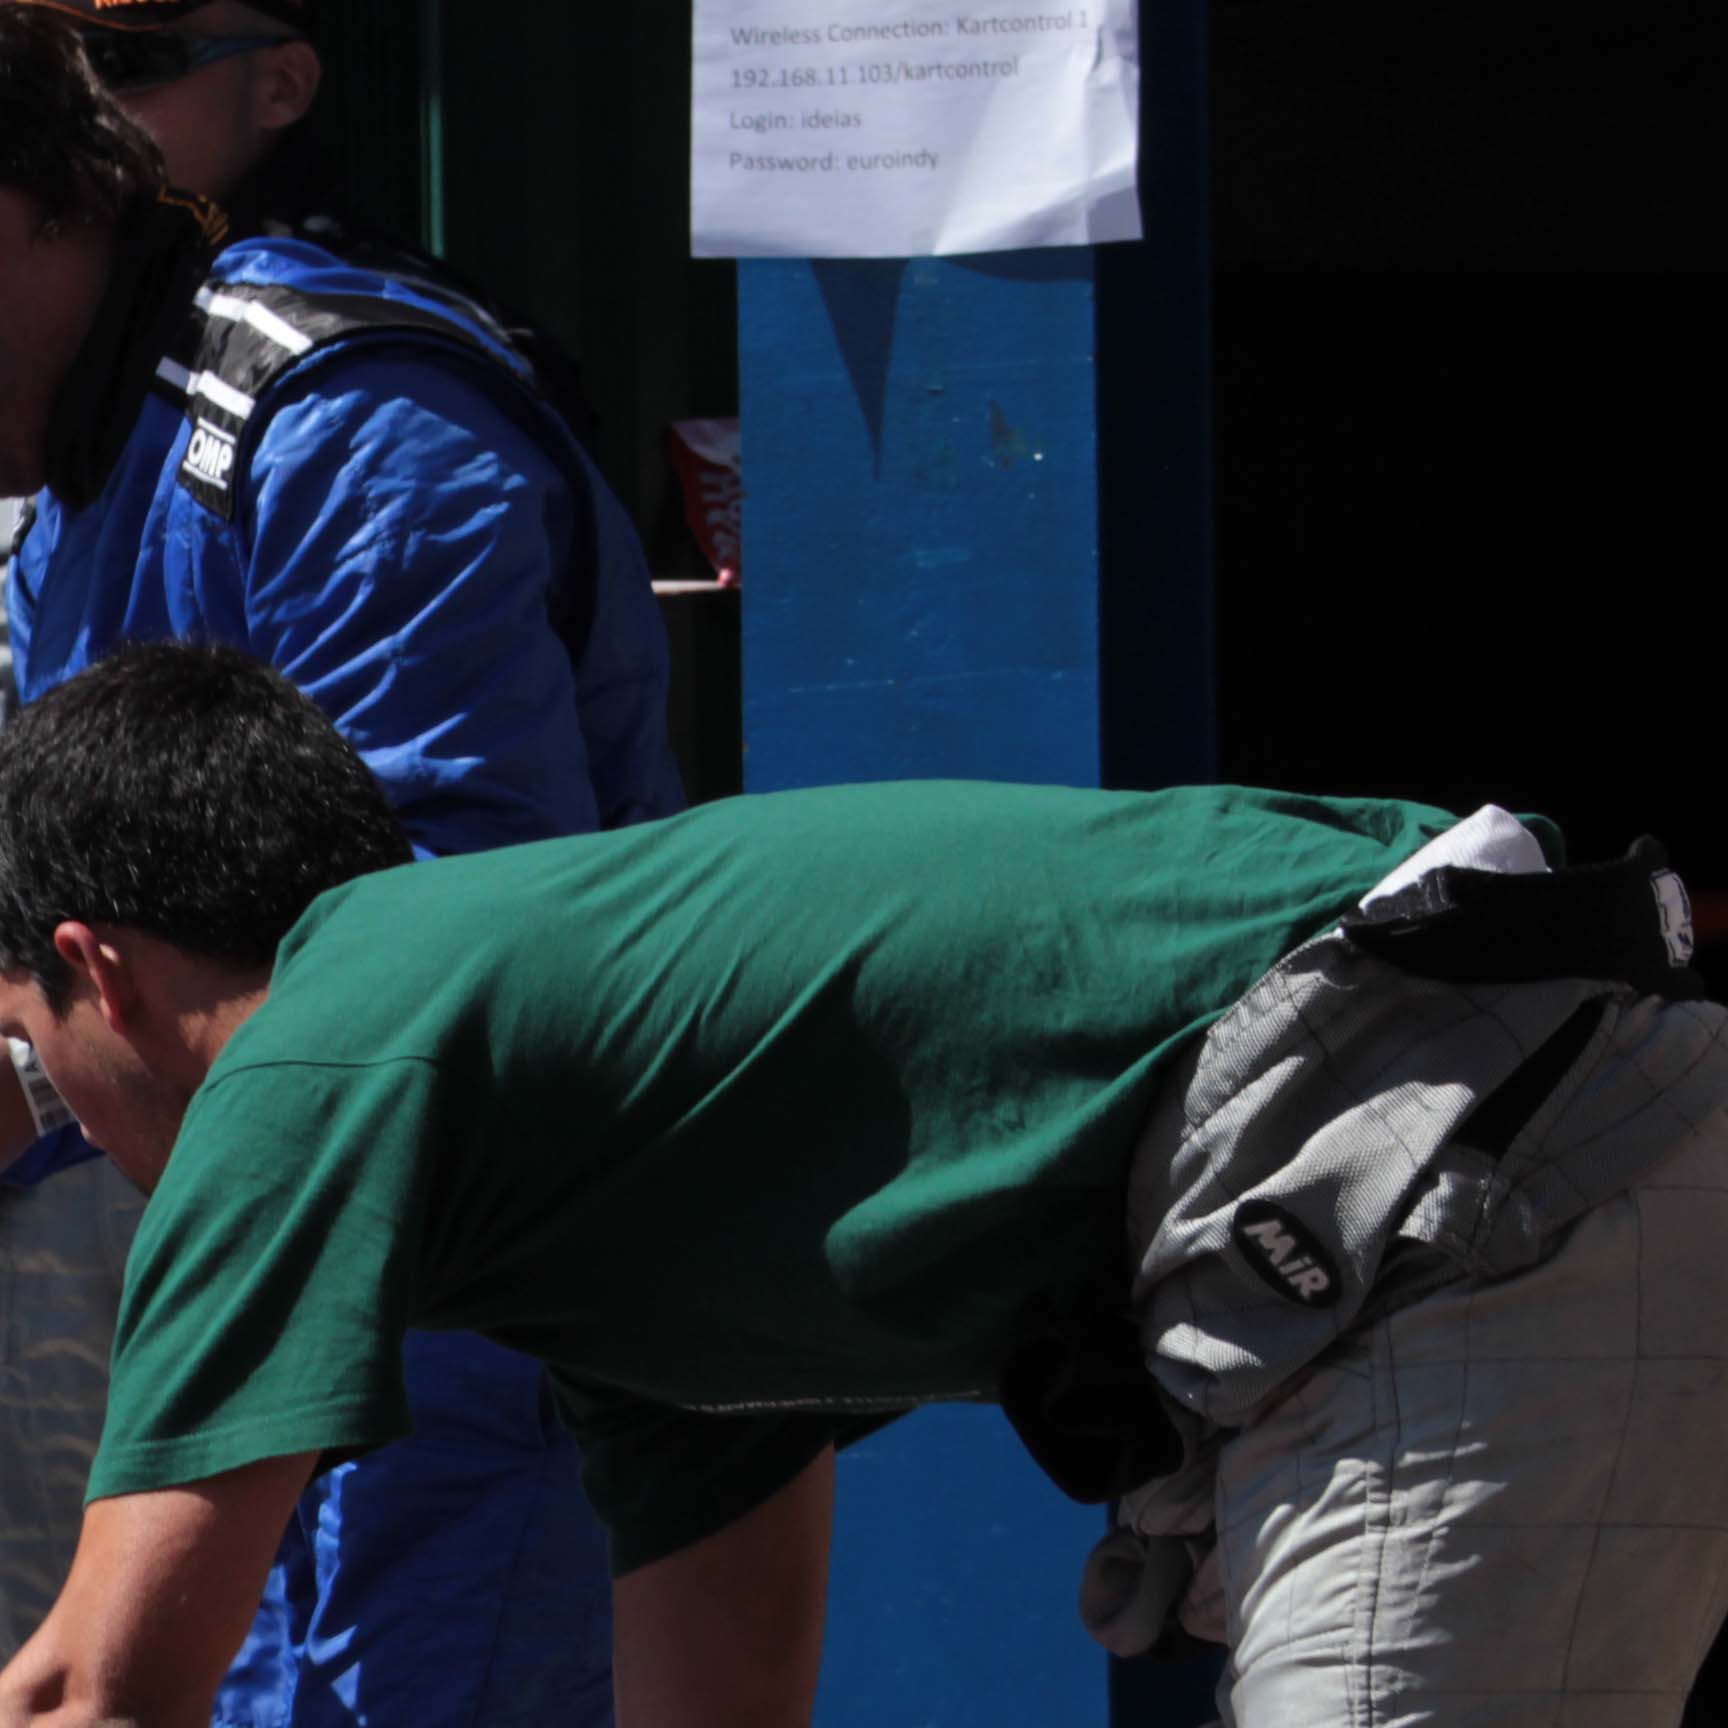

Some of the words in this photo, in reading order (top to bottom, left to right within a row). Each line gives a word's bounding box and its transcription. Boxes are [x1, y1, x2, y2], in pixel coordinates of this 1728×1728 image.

[731, 26, 823, 47] Wireless
[827, 19, 949, 44] Connection:
[956, 9, 1075, 37] Kartcontrol
[729, 110, 795, 134] Login:
[729, 150, 840, 172] Password:
[846, 147, 940, 173] euroindy
[188, 428, 234, 479] OMP
